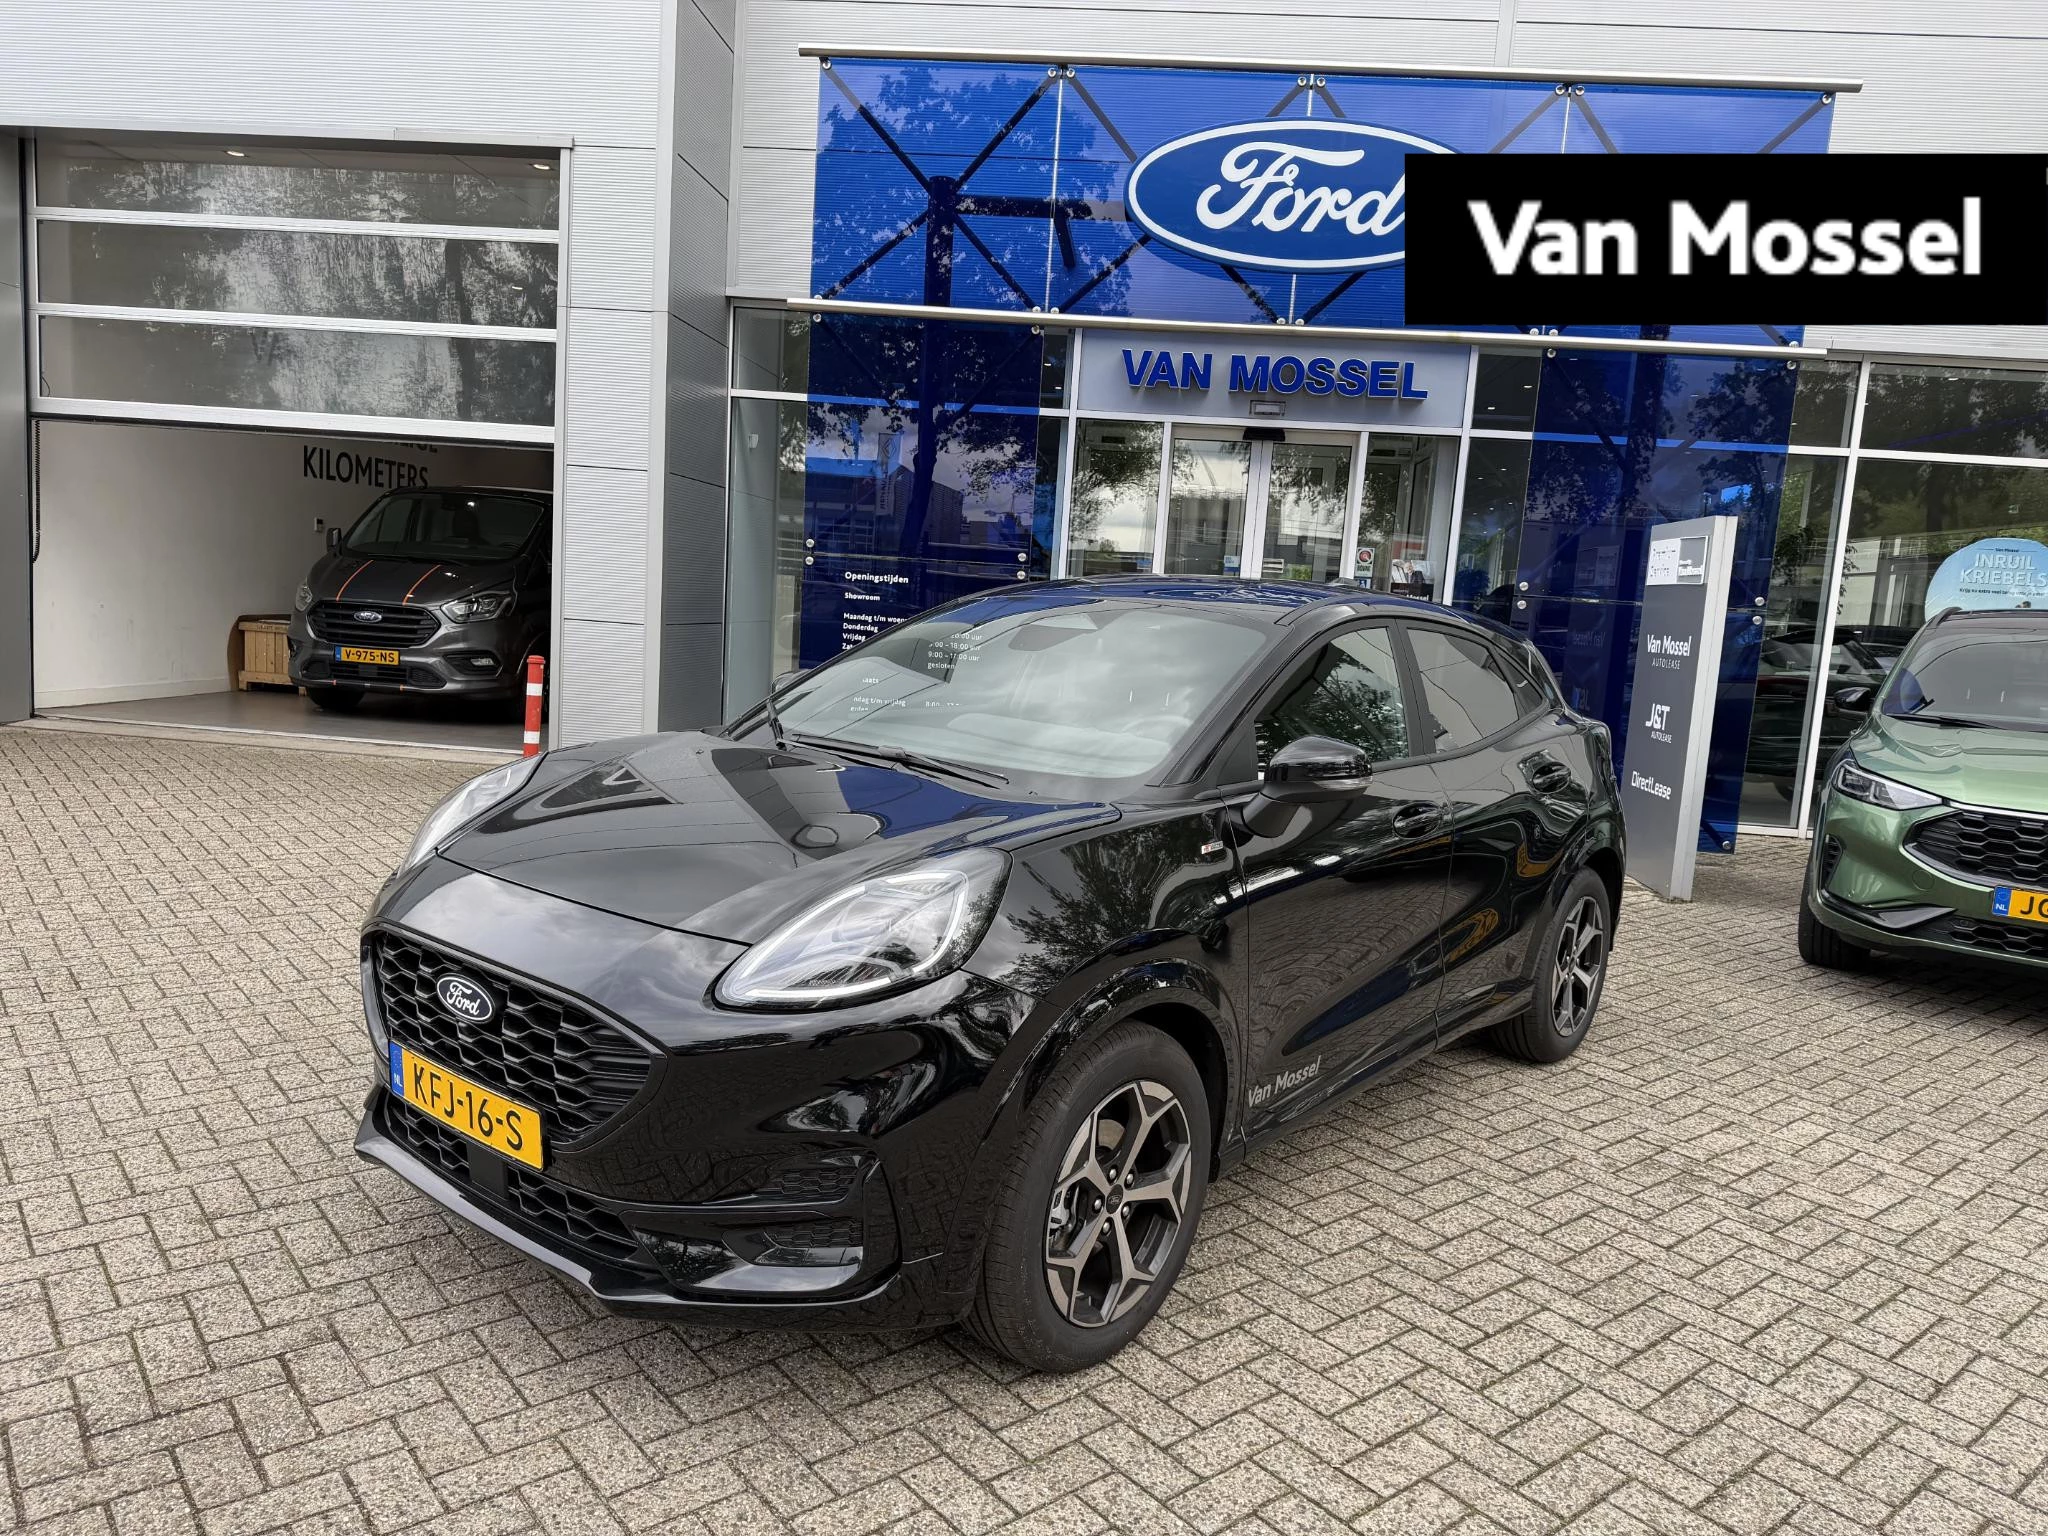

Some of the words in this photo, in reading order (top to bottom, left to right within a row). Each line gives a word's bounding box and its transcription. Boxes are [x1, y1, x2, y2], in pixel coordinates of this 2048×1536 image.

[1196, 141, 1405, 236] Ford
[1122, 349, 1212, 390] VAN
[1228, 354, 1428, 400] MOSSEL
[303, 445, 428, 489] KILOMETERS
[1974, 553, 2037, 570] INRUIL
[844, 571, 909, 584] Openingstijden
[1959, 568, 2048, 588] KRIEBELS
[844, 592, 880, 601] Showroom
[843, 613, 873, 622] Maandag
[873, 614, 886, 622] t/m
[843, 623, 878, 633] Donderdag
[842, 633, 866, 642] Vrijdag
[1647, 634, 1661, 653] Van
[1661, 635, 1692, 657] Mossel
[345, 649, 395, 663] V-975-NS
[1651, 658, 1681, 670] AUTOLEASE
[927, 661, 955, 669] gesloten
[1645, 703, 1671, 731] J&T
[1650, 731, 1672, 743] AUTOLEASE
[1631, 770, 1672, 800] DirectLease
[1995, 903, 2008, 911] NL
[446, 981, 480, 1016] Ford
[393, 1072, 403, 1087] NL
[1248, 1084, 1271, 1108] Van
[1274, 1055, 1322, 1094] Mossel
[413, 1062, 523, 1151] KFJ-16-S
